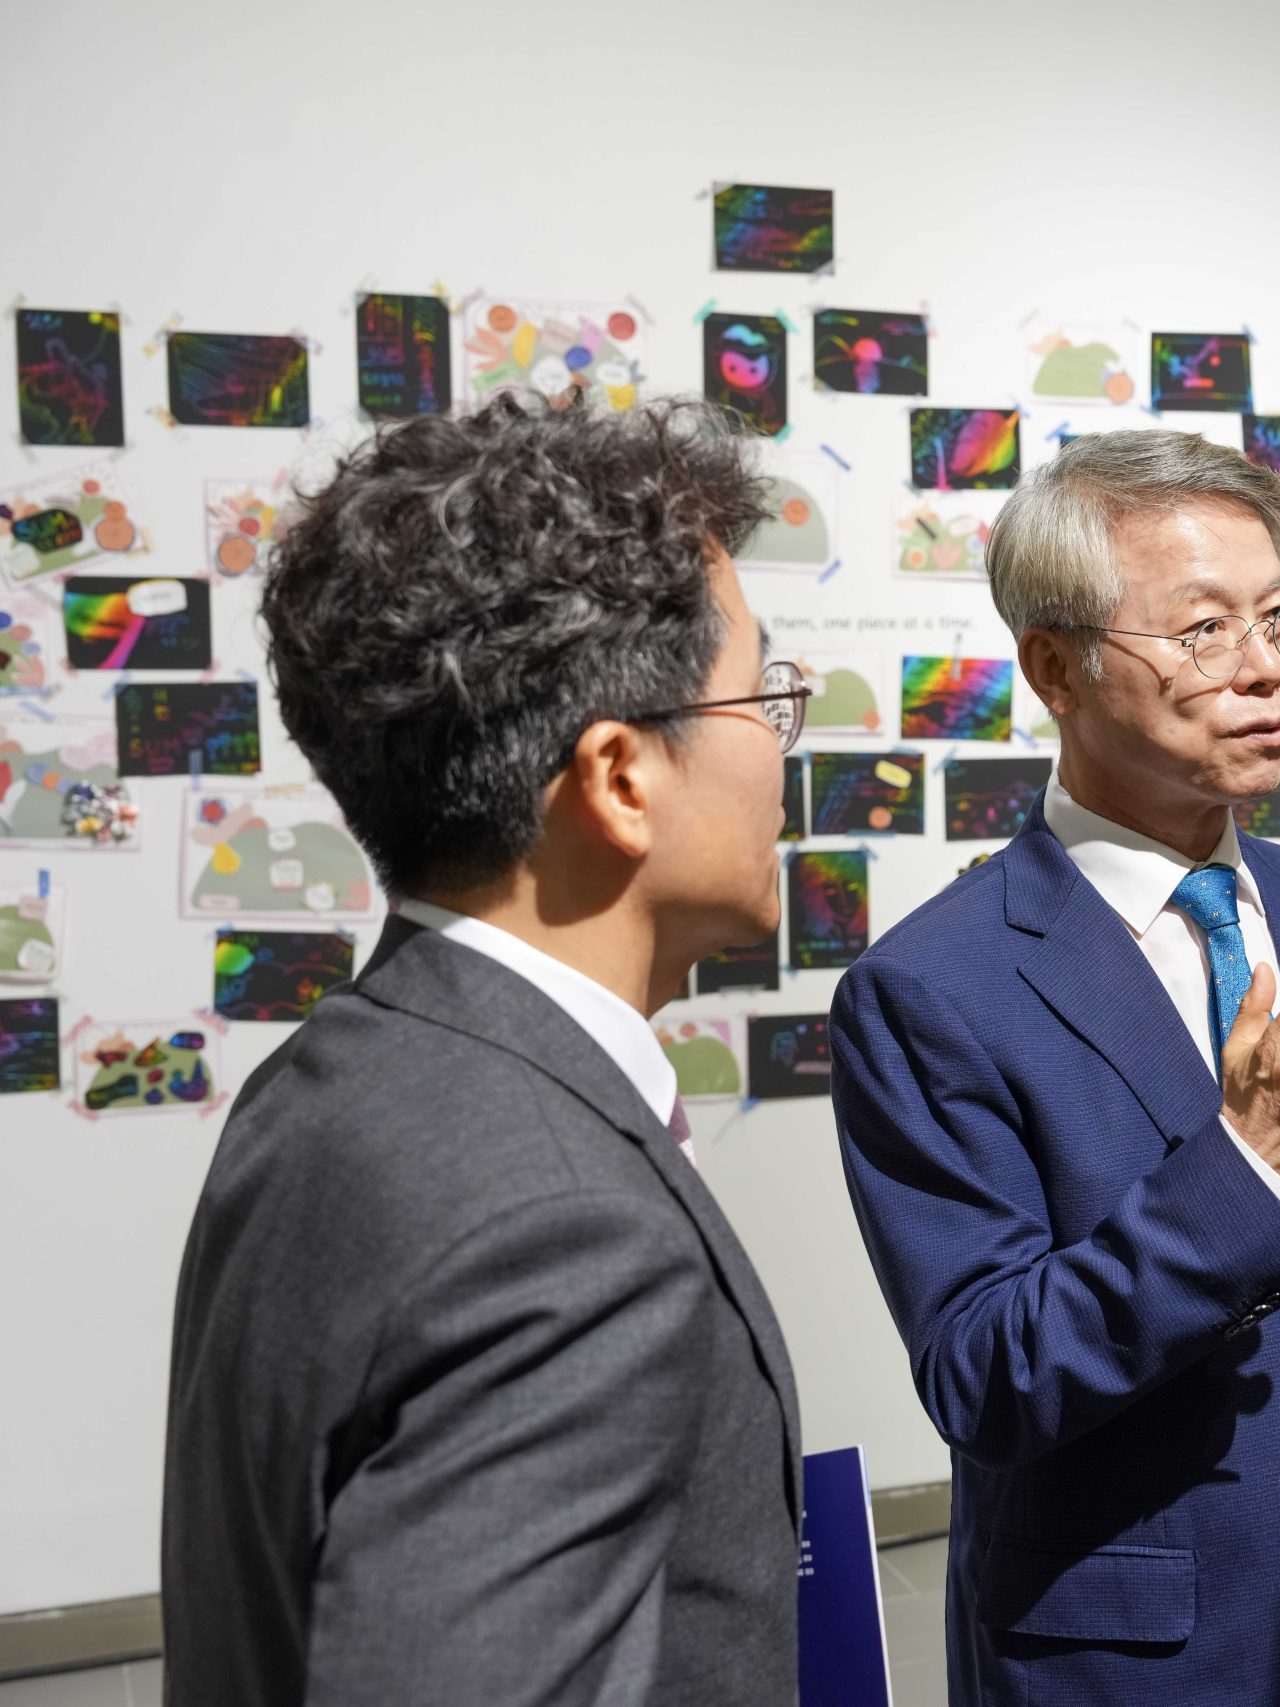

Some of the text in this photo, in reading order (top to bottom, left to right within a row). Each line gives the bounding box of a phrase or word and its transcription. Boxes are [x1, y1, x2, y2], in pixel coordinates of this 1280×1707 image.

[823, 617, 851, 630] one
[856, 615, 897, 632] piece
[903, 616, 919, 630] at
